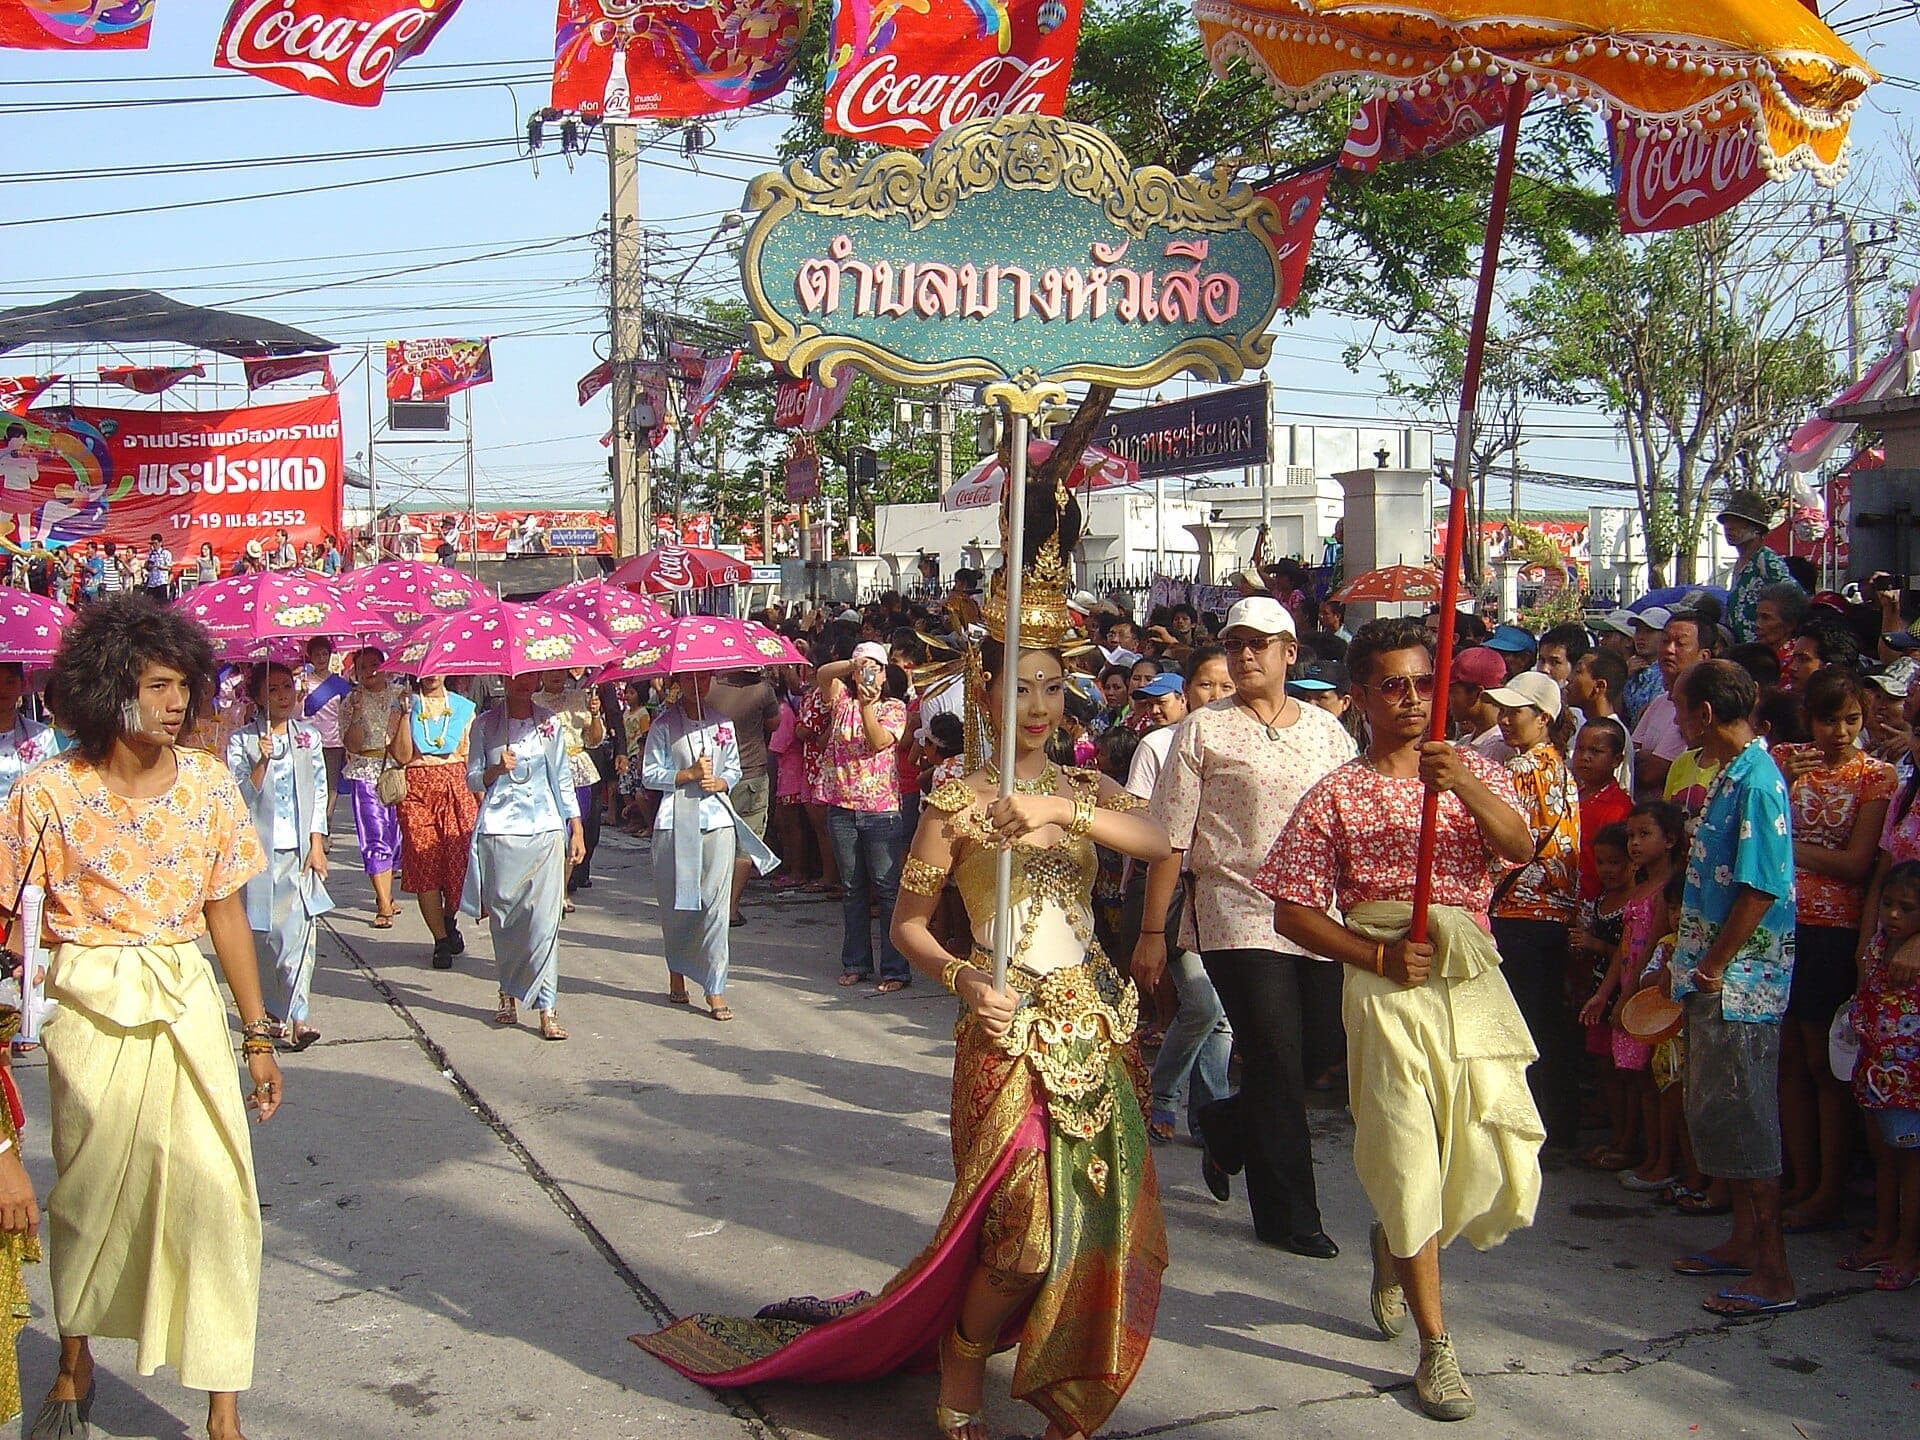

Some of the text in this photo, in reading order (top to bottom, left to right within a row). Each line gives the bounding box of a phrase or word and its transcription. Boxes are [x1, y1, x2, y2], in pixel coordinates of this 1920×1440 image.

[226, 0, 440, 88] Coca-C
[836, 54, 1065, 134] Coca-Cola
[798, 236, 1240, 326] ตำบลบางหัวเสือ
[123, 419, 340, 449] งานประเพณีสงกรานต์
[137, 454, 327, 497] พระประแดง
[170, 513, 221, 529] 17-19
